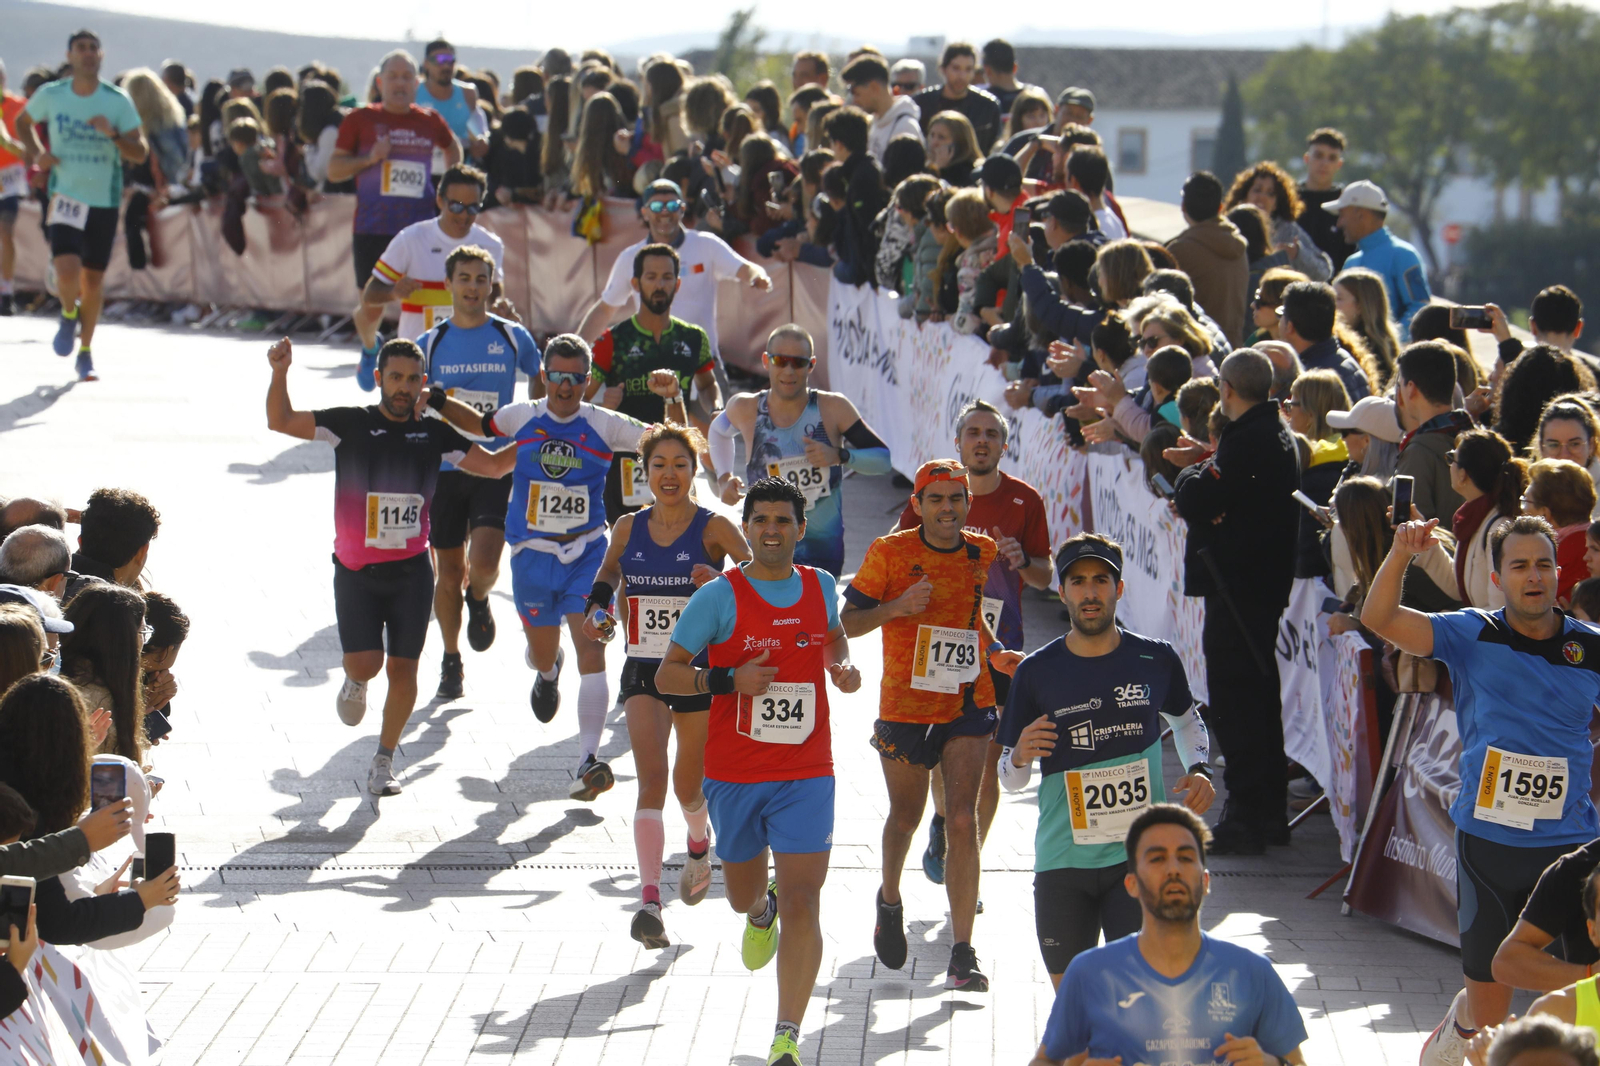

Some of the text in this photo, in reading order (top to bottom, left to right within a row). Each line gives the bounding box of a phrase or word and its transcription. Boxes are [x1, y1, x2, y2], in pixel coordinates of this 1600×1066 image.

[440, 364, 506, 374] TROTASIERRA
[787, 467, 822, 486] 935
[540, 495, 585, 514] 1248
[380, 506, 418, 525] 1145
[626, 575, 694, 586] TROTASIERRA
[645, 609, 680, 630] 351
[752, 637, 780, 648] califas
[931, 641, 975, 666] 1793
[1114, 683, 1144, 701] 365
[761, 698, 804, 722] 334
[1118, 699, 1150, 708] TRAINING
[1094, 723, 1143, 736] CRISTALERIA
[1512, 758, 1545, 768] IMDECO
[1092, 768, 1124, 778] IMDECO
[1484, 771, 1494, 795] CAJÓN
[1501, 769, 1563, 800] 1595
[1084, 776, 1147, 810] 2035
